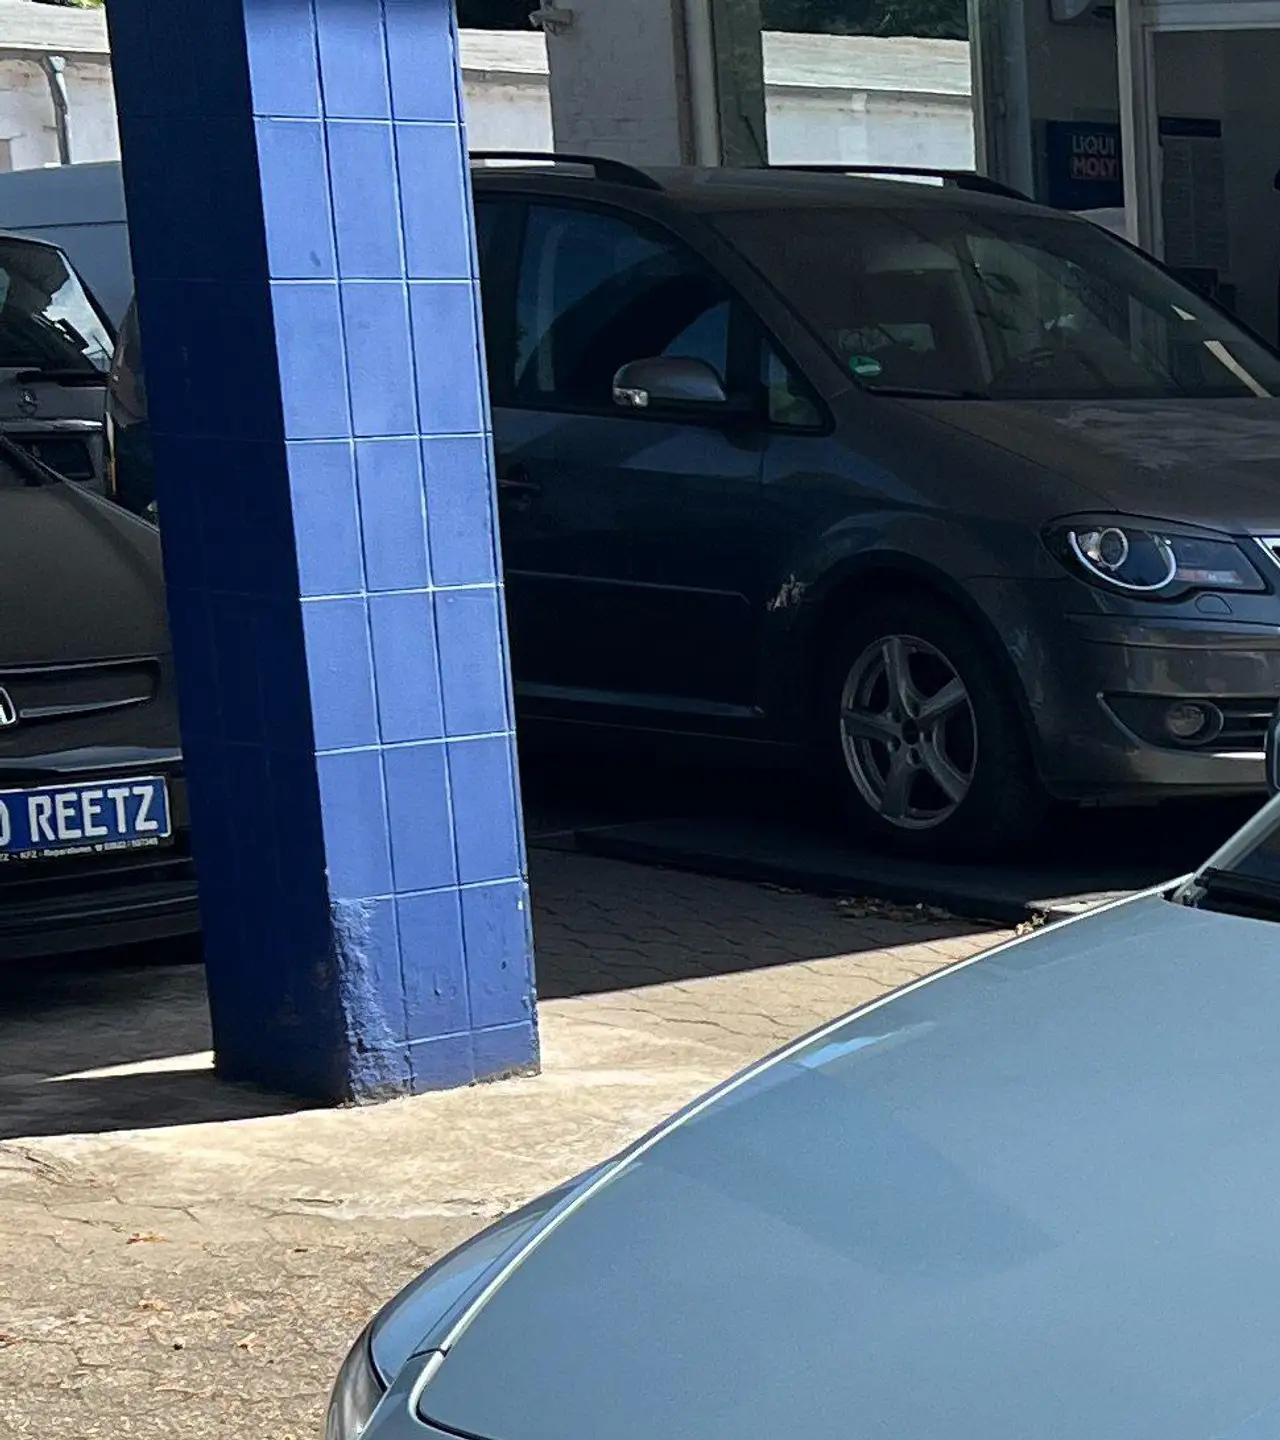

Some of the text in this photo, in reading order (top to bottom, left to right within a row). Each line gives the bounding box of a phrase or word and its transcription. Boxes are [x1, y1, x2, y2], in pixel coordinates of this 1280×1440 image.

[1072, 134, 1116, 154] LIQUI
[1071, 157, 1117, 178] MOLY
[28, 785, 160, 843] REETZ
